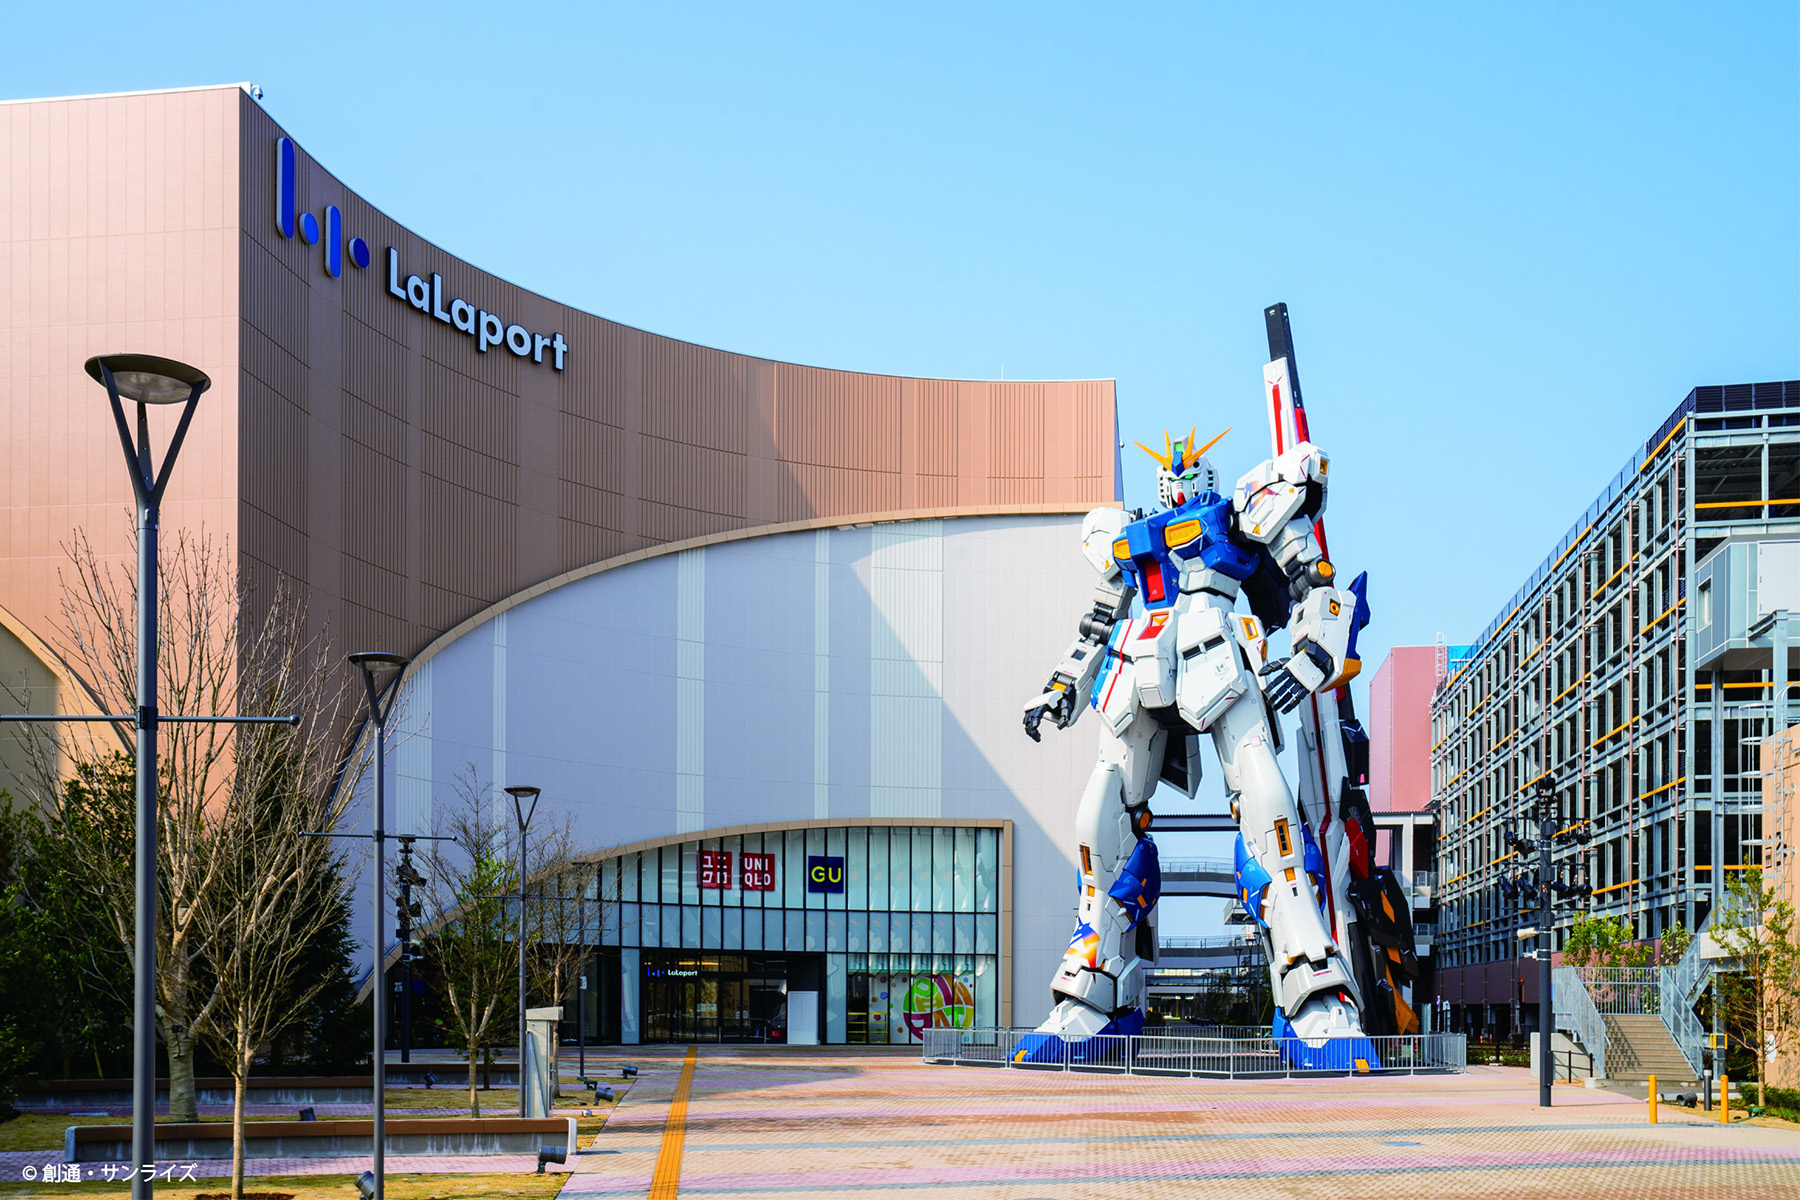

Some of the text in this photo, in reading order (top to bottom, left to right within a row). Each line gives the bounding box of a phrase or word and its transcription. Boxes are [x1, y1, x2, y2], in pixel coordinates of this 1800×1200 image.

[387, 246, 568, 371] LaLaport
[744, 857, 769, 871] UNI
[744, 872, 771, 886] QLO
[811, 865, 842, 883] GU
